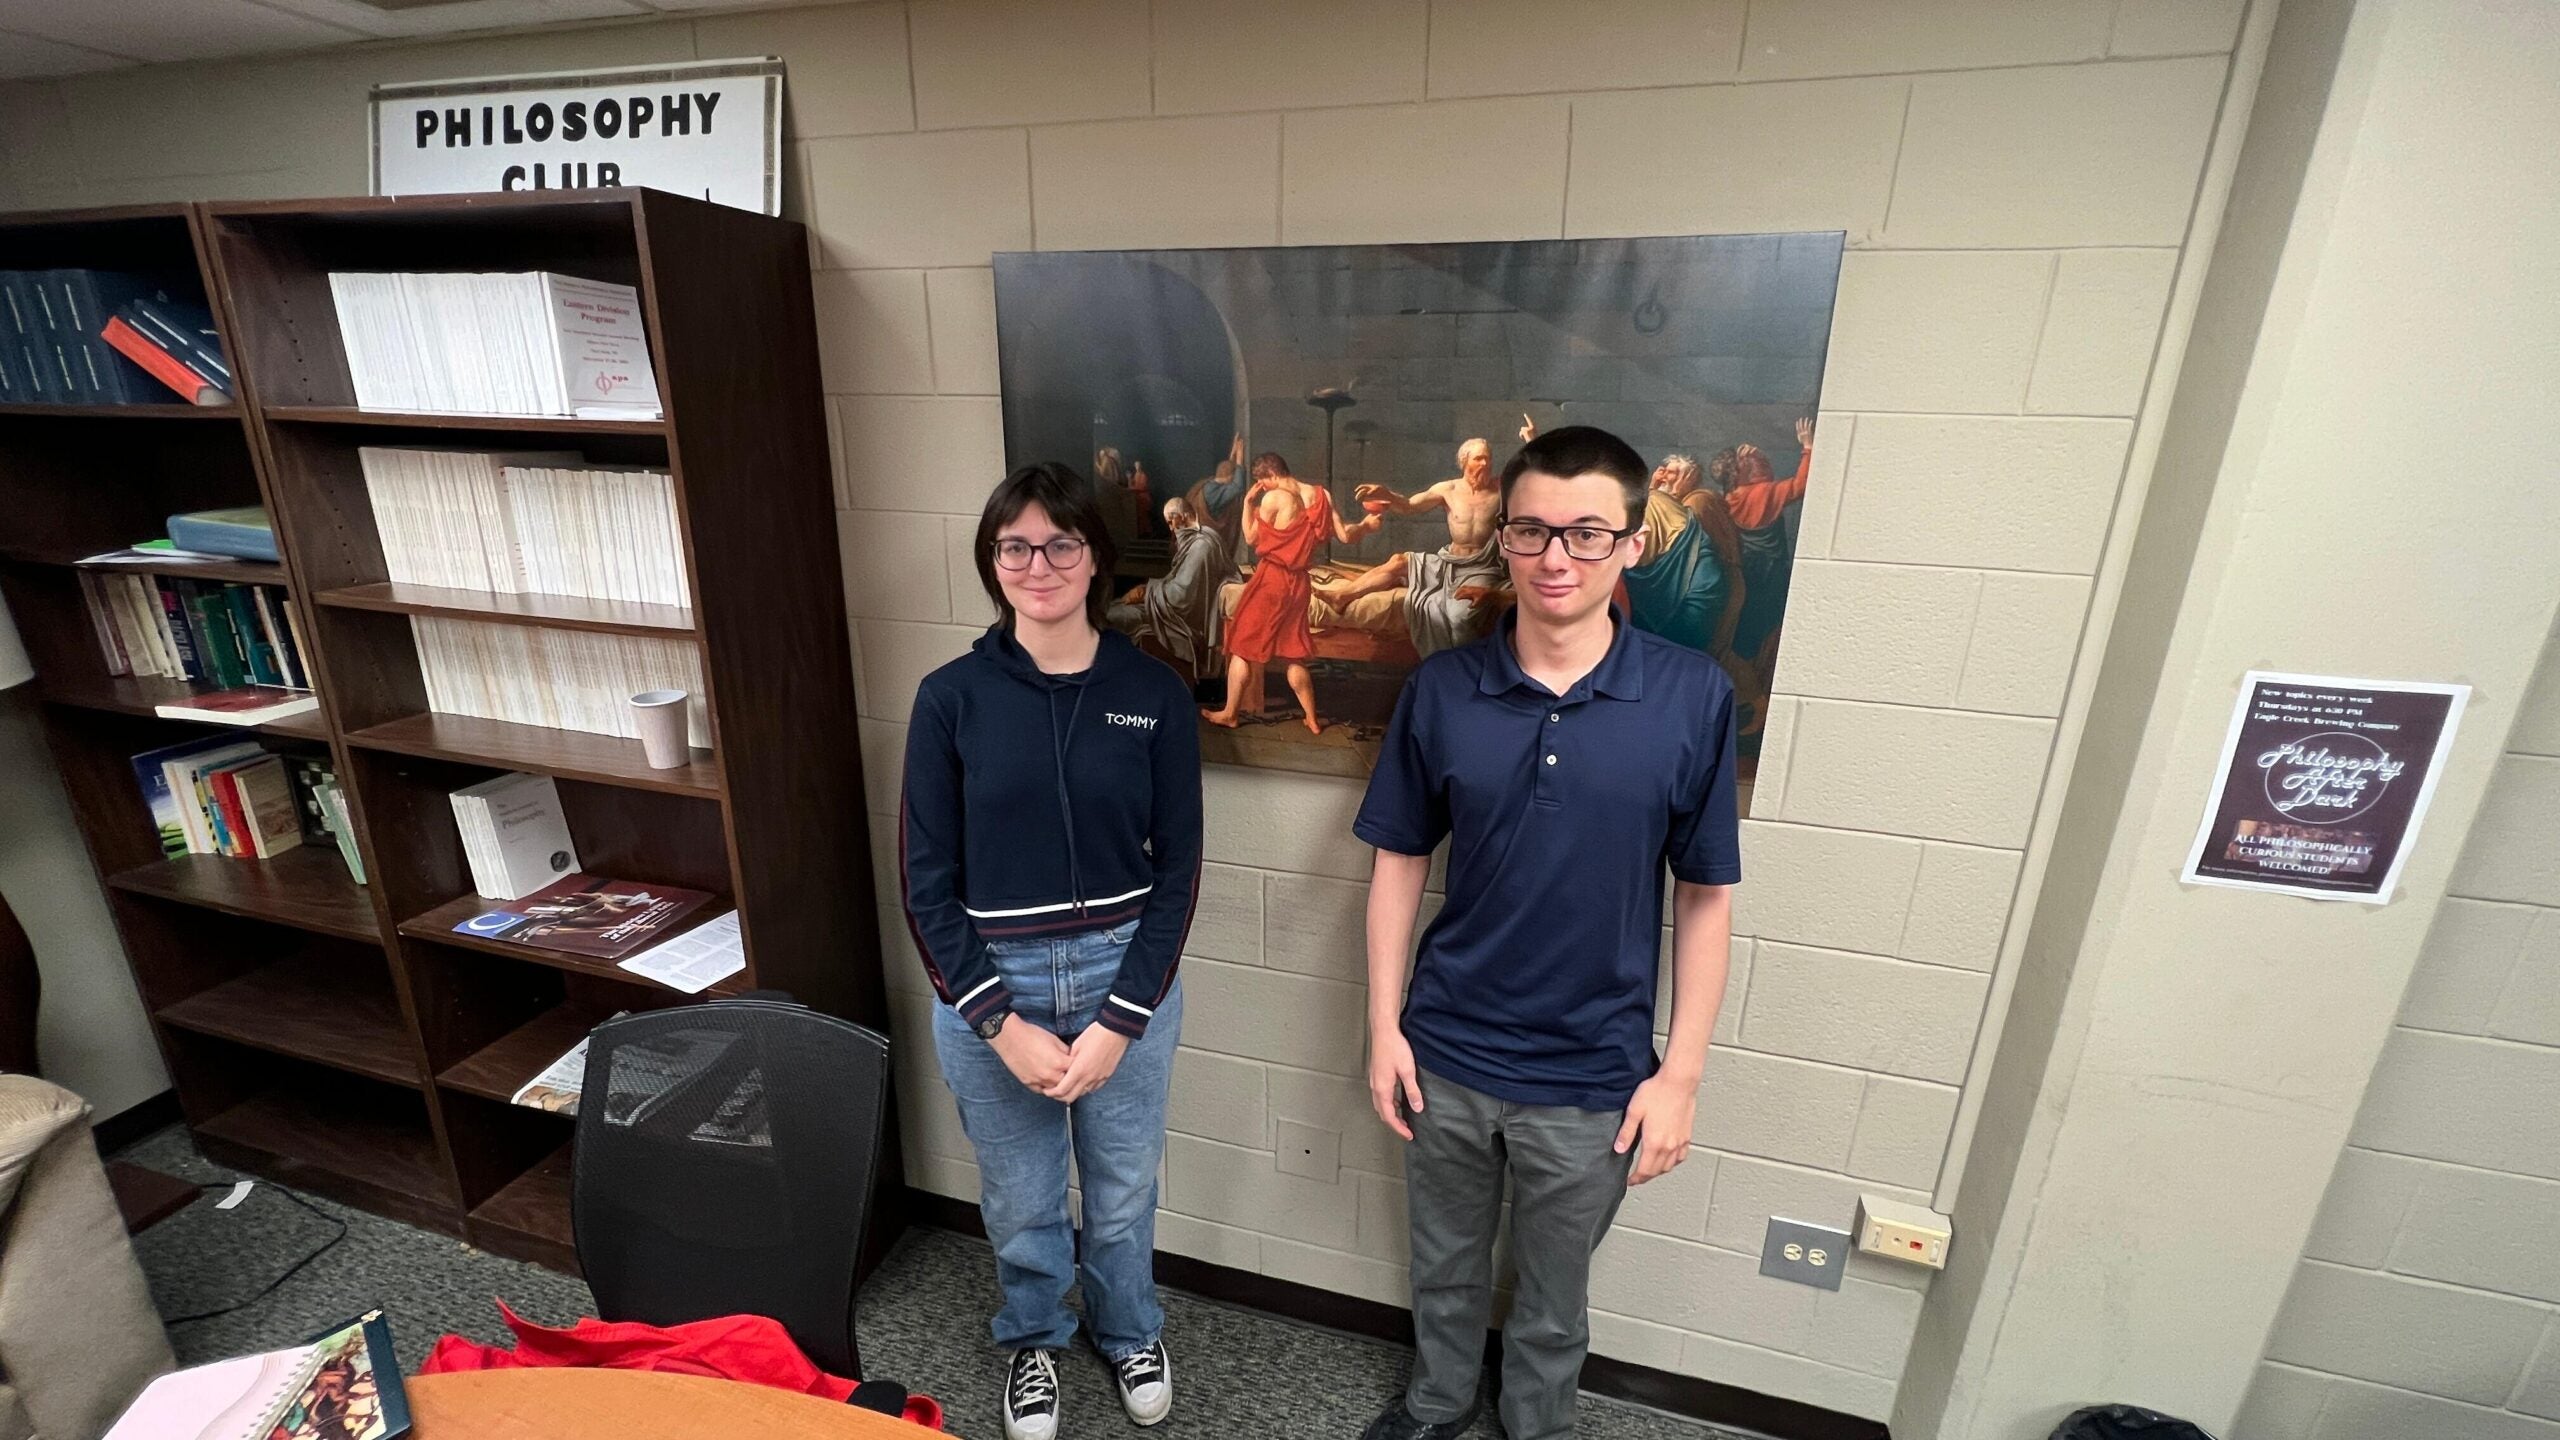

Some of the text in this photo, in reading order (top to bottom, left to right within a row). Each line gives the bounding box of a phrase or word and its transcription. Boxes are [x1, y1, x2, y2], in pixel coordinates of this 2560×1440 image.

[416, 92, 721, 148] PHILOSOPHY
[581, 312, 616, 324] Program
[597, 304, 630, 315] Division
[2286, 691, 2313, 700] topics
[2316, 694, 2345, 702] every
[2349, 696, 2373, 704] week
[2258, 701, 2308, 712] Thursdays
[2346, 708, 2363, 716] PM
[1105, 713, 1158, 730] TOMMY
[2254, 713, 2280, 722] Eagle
[2283, 715, 2310, 724] Creek
[2314, 718, 2354, 729] Brewing
[2257, 744, 2405, 781] Philosophy
[2282, 768, 2367, 791] After
[2276, 786, 2358, 812] Dark
[2234, 835, 2373, 854] ALL PHILOSOPHICALLY
[2239, 846, 2359, 865] CURIOUS STUDENTS
[2258, 860, 2332, 874] WELCOMED!
